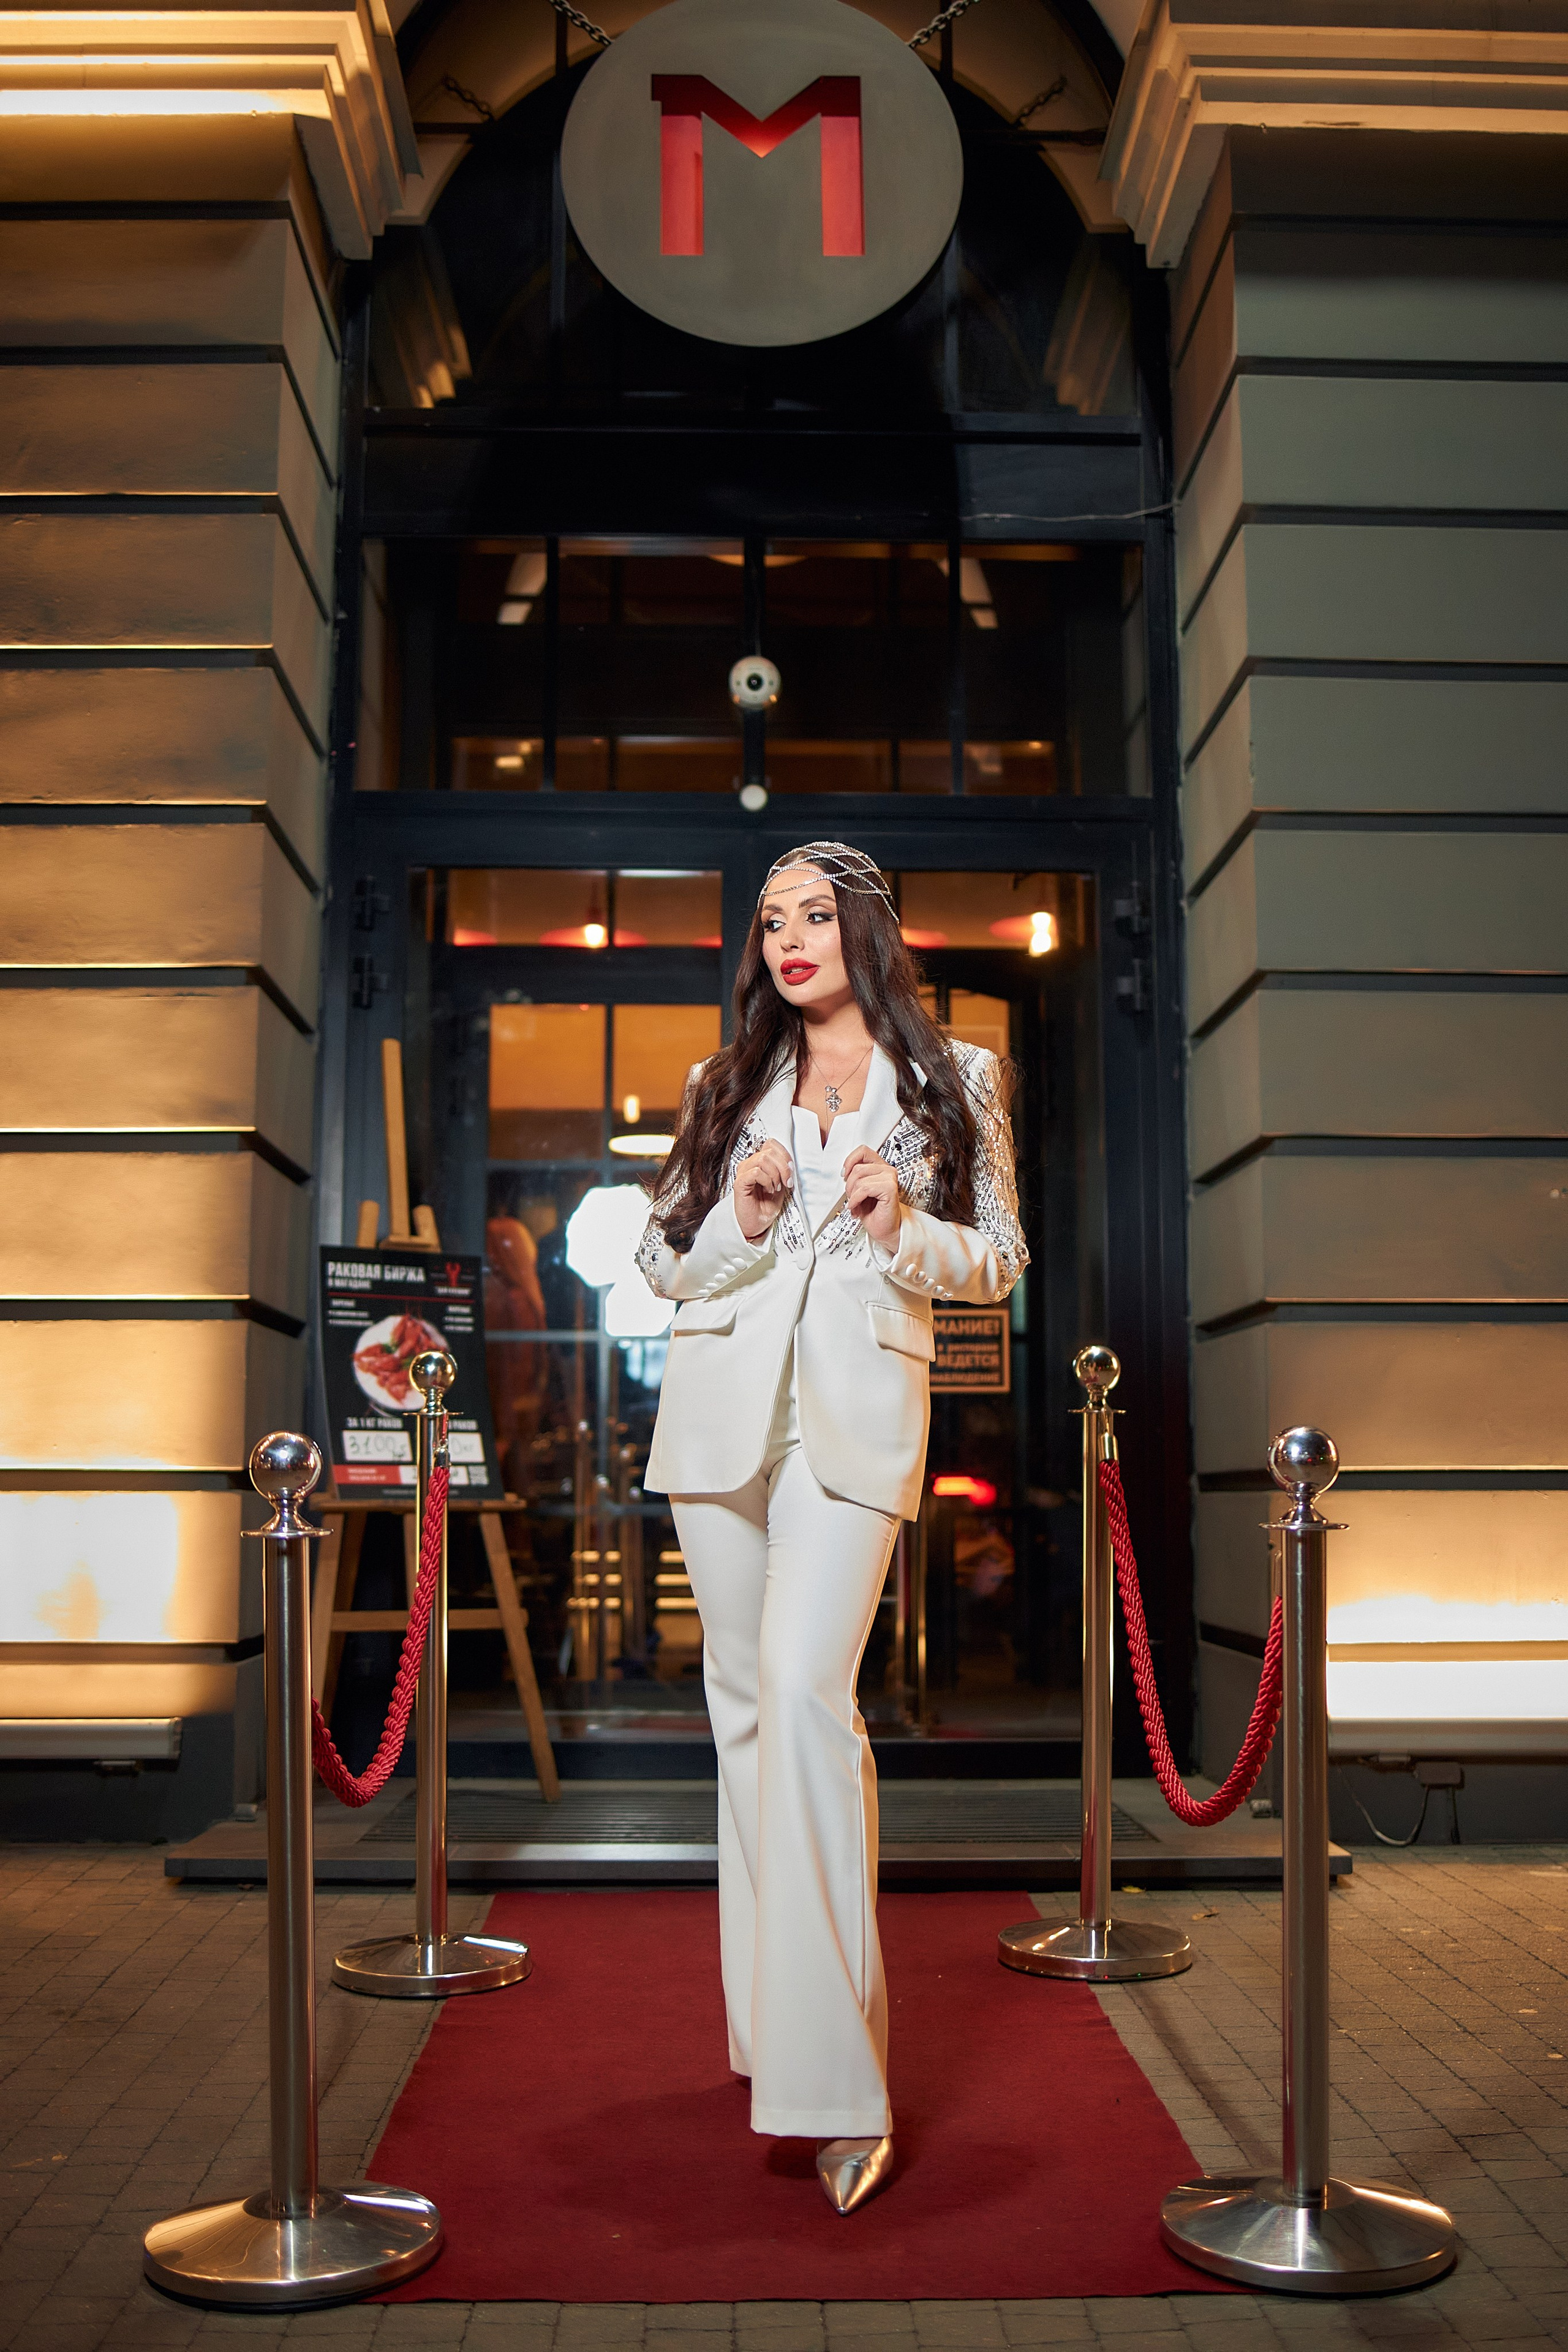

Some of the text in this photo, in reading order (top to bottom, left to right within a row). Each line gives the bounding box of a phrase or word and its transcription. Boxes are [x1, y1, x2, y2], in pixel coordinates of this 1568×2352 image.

[328, 1261, 381, 1279] РАКОВАЯ
[384, 1265, 426, 1282] БИРЖА
[933, 1319, 1000, 1336] МАНИЕ!
[930, 1373, 1000, 1383] НАБЛЮДЕНИЕ
[377, 1417, 402, 1429] РАКОВ
